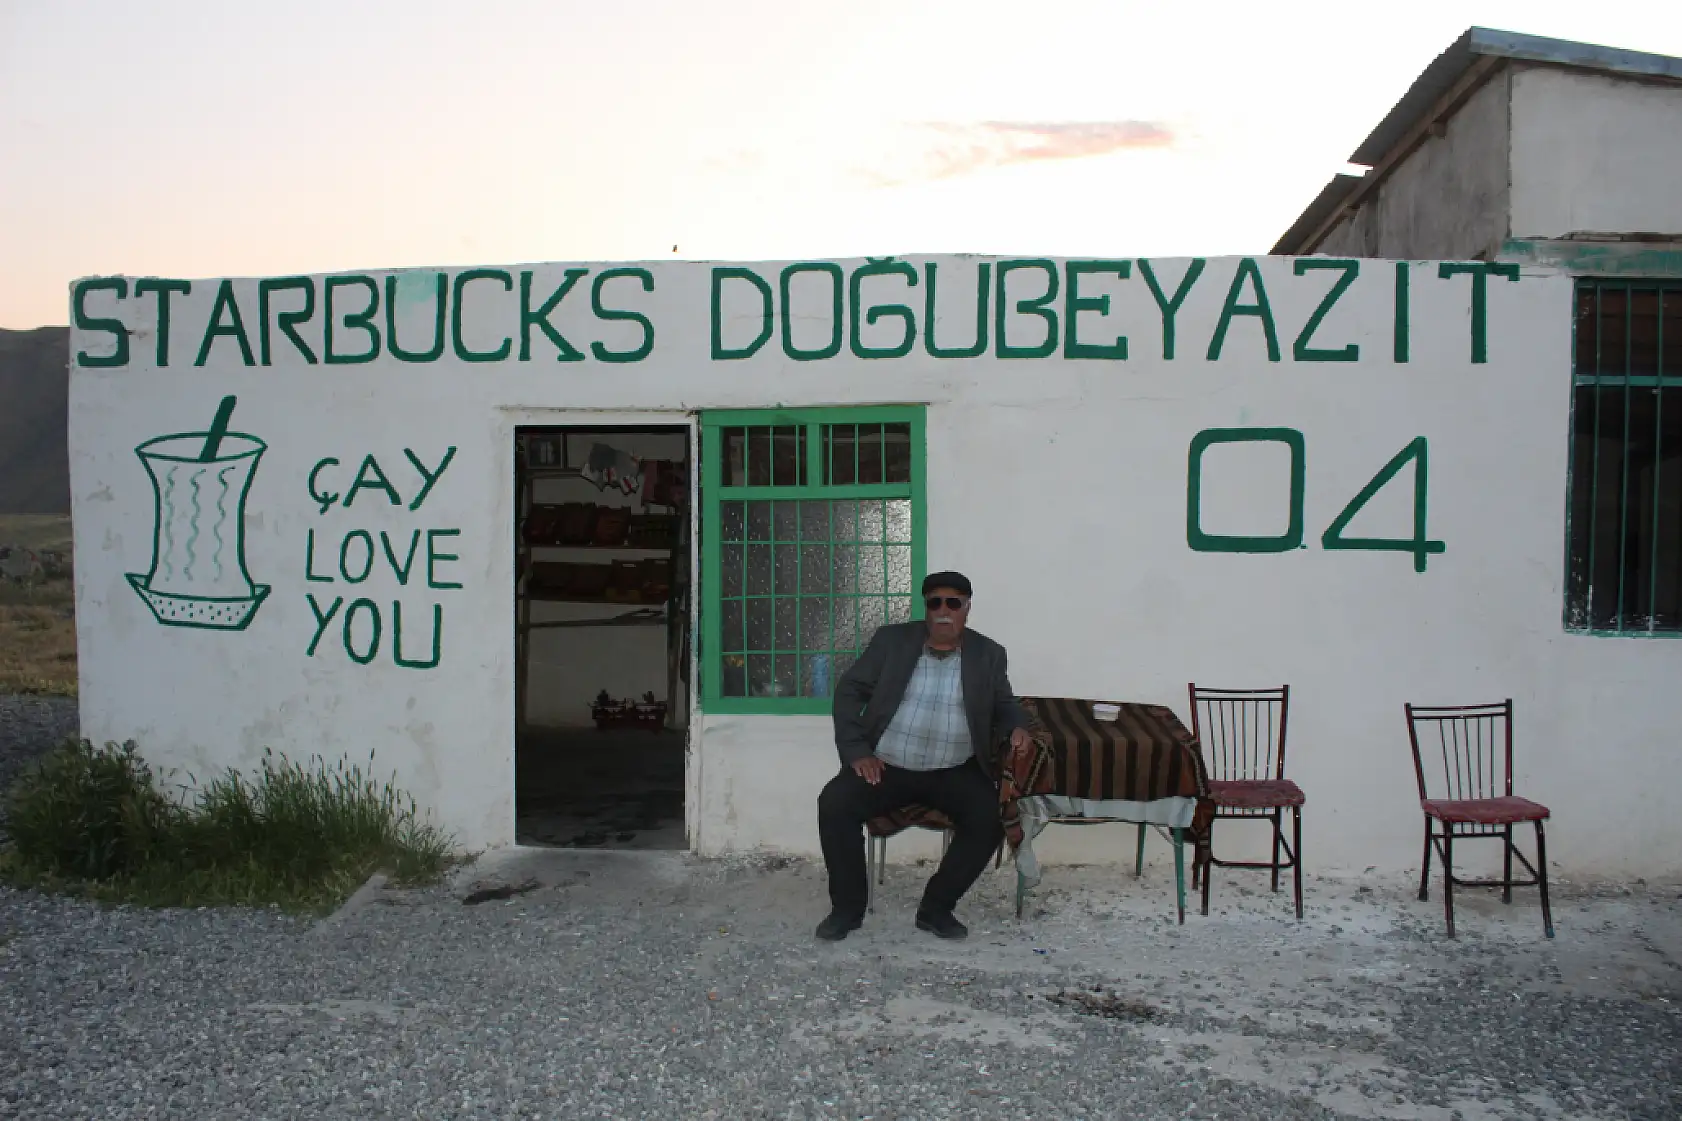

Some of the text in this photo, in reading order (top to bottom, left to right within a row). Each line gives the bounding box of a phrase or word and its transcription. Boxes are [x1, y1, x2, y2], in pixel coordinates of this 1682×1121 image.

[73, 255, 1522, 367] STARBUCKS DOĞUBEYAZIT
[306, 446, 457, 515] ÇAY
[1188, 427, 1447, 574] 04
[303, 528, 462, 589] LOVE
[304, 593, 441, 669] YOU
